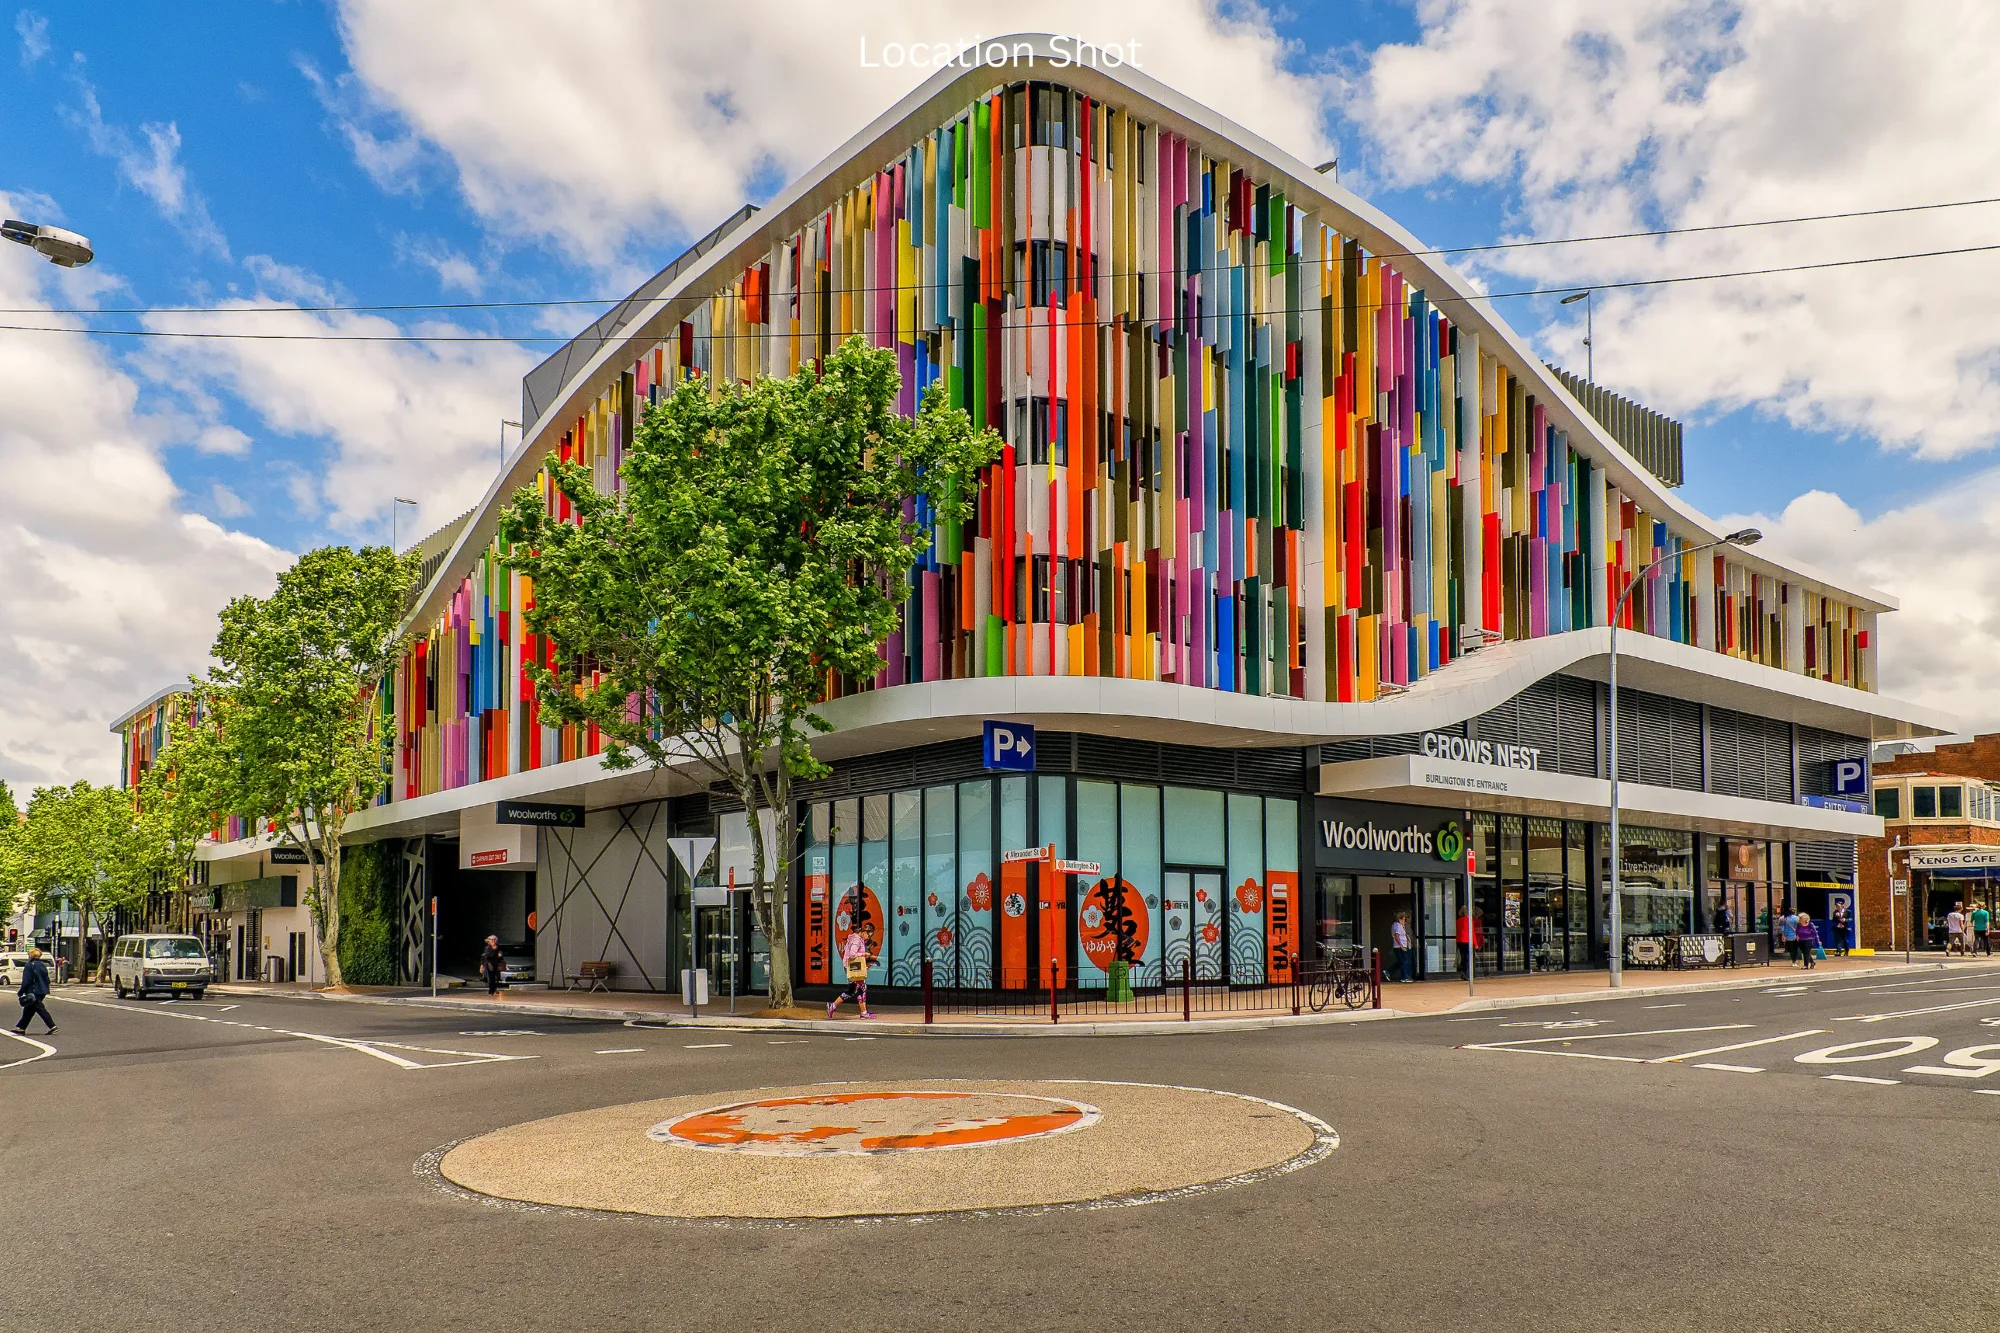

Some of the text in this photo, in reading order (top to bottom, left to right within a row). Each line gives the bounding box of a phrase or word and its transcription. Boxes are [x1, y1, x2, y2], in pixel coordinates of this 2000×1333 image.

[993, 728, 1015, 762] P
[1423, 732, 1541, 771] CROWS NEST
[1425, 773, 1466, 787] BURLINGTON
[1476, 780, 1508, 792] ENTRANCE
[1837, 762, 1861, 792] P
[508, 809, 558, 821] Woolworths
[1322, 820, 1433, 854] Woolworths
[1009, 850, 1033, 858] Alexander
[1914, 855, 1997, 865] XENOS CAFE
[1065, 861, 1089, 871] Burlington
[1617, 859, 1669, 875] liverBrown
[1086, 940, 1116, 953] ゆめや
